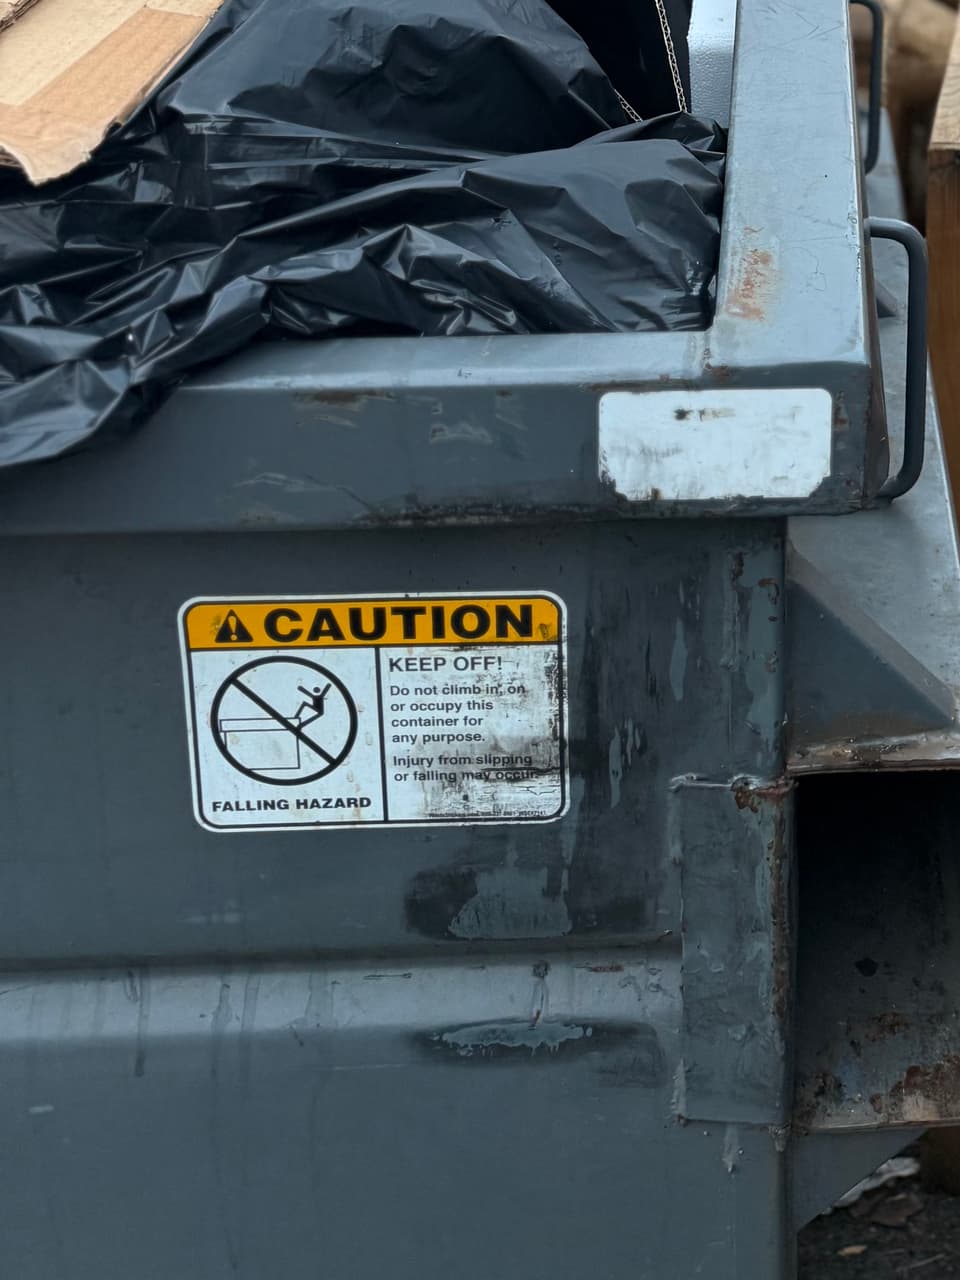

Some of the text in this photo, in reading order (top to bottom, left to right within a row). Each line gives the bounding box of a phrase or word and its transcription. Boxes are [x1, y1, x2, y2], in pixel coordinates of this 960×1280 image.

[264, 604, 533, 642] CAUTION
[389, 655, 502, 672] KEEP OFF!
[390, 684, 410, 696] Do
[414, 683, 438, 696] not
[442, 682, 481, 695] climb
[507, 683, 525, 694] on
[390, 699, 494, 713] or occupy this
[391, 715, 484, 728] container for
[392, 731, 485, 745] any purpose.
[393, 752, 533, 768] Injury from slipping
[394, 772, 409, 782] or
[413, 770, 457, 783] falling
[462, 770, 491, 782] may
[211, 796, 372, 813] FALLING HAZARD
